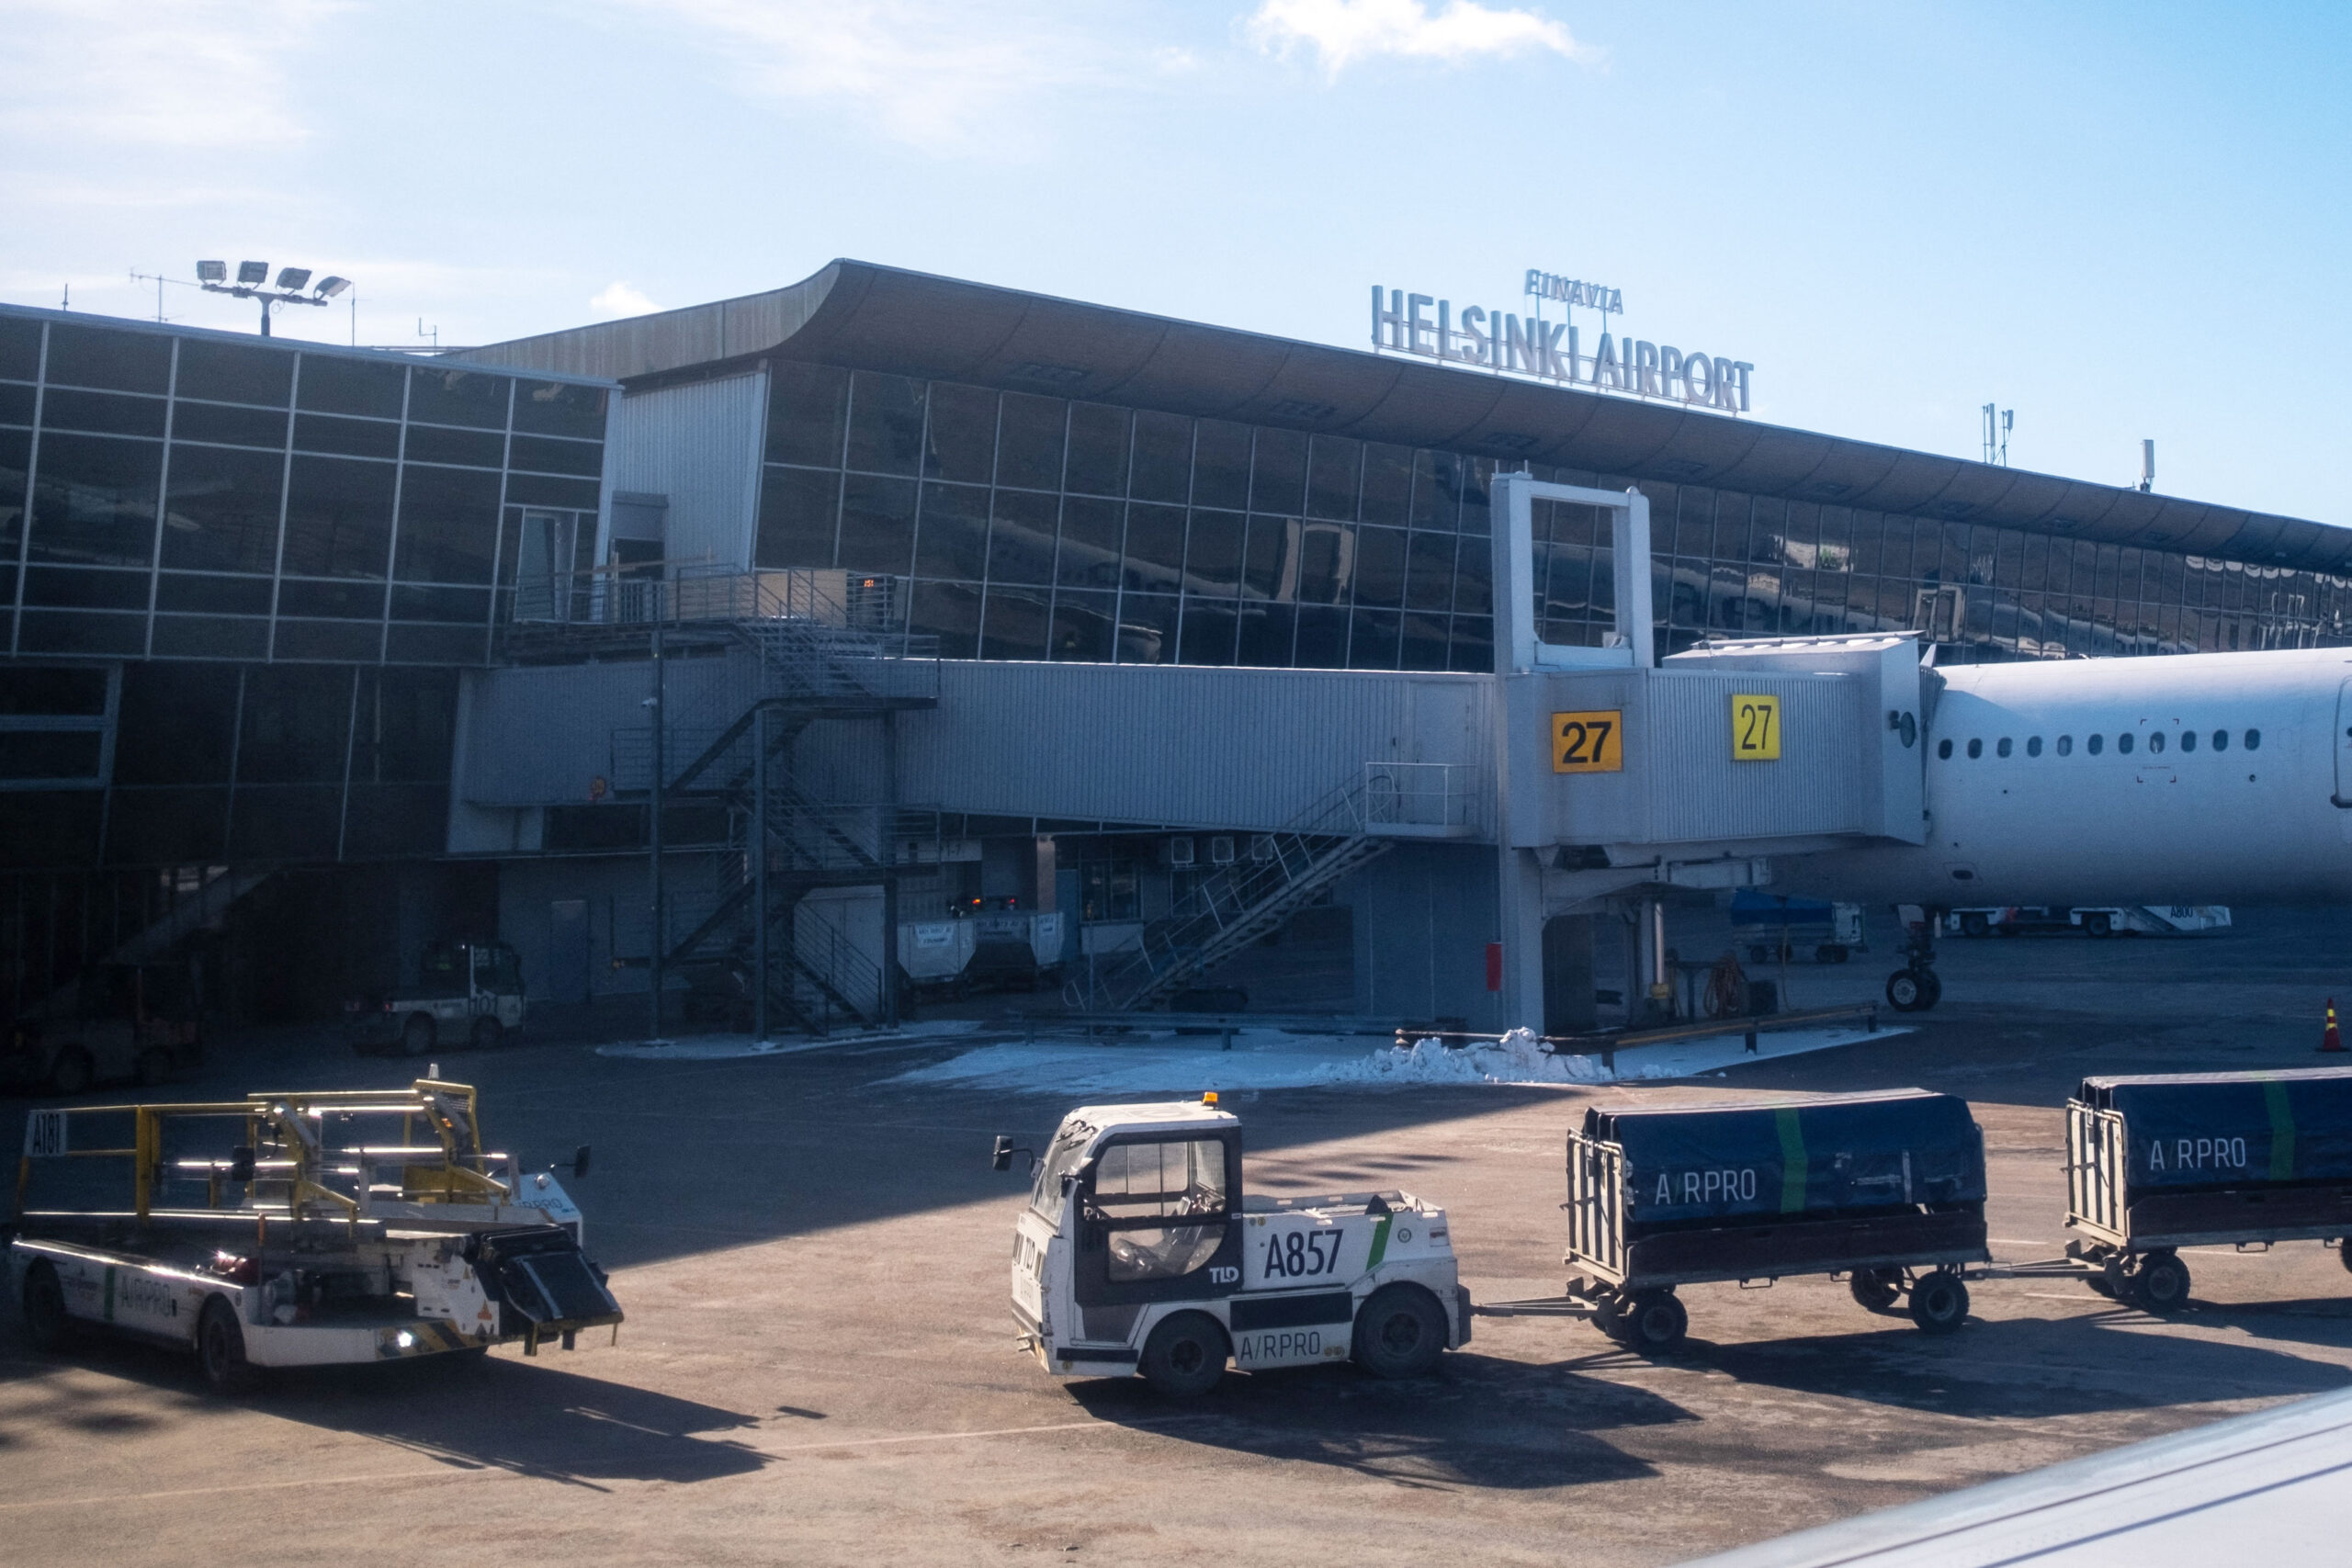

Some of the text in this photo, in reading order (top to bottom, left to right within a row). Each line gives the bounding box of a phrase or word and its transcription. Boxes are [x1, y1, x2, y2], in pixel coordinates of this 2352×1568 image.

[1525, 269, 1623, 314] FINAVIA
[1372, 285, 1753, 412] HELSINKI AIRPORT
[1562, 721, 1611, 763] 27
[1740, 704, 1771, 750] 27
[32, 1113, 59, 1154] A181
[1209, 1266, 1239, 1284] TLD
[1264, 1229, 1343, 1278] A857
